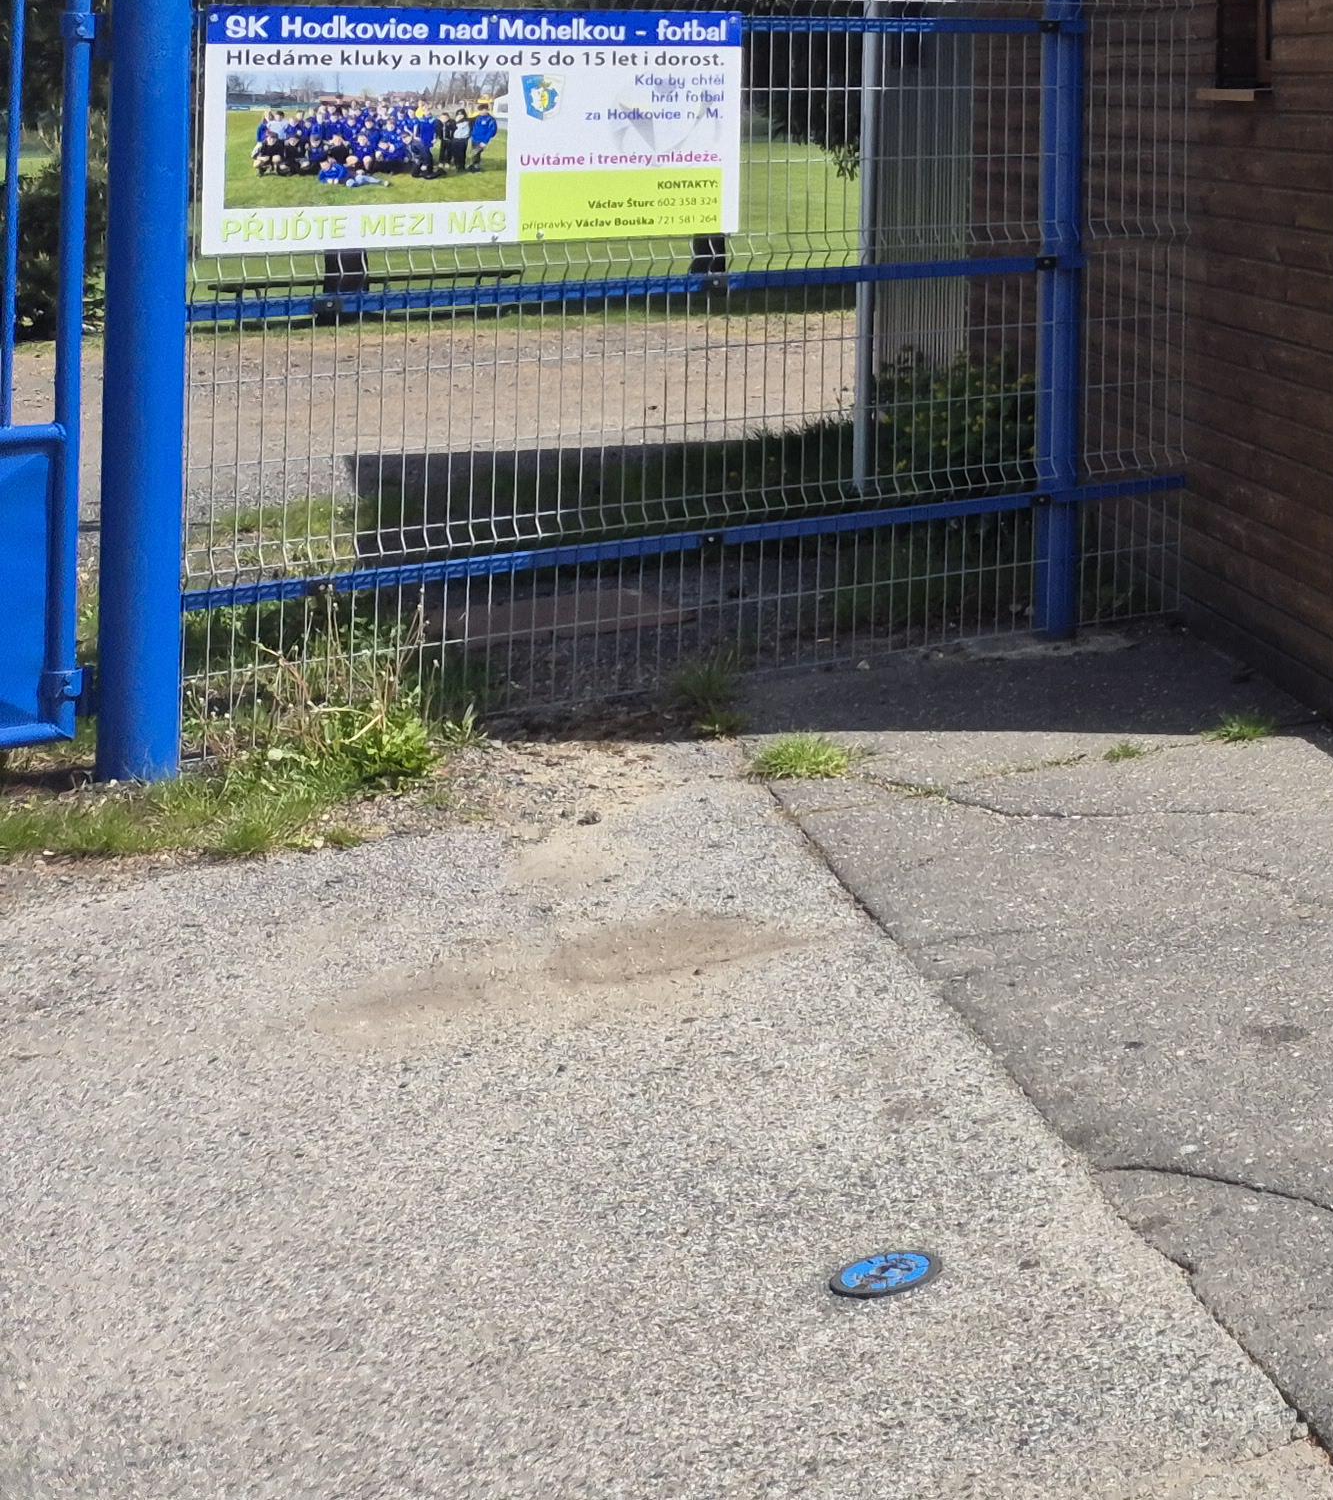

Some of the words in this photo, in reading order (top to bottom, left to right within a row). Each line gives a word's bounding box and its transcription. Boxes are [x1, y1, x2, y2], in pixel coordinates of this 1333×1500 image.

[226, 15, 269, 38] SK
[281, 15, 428, 39] Hodkovice
[439, 17, 488, 40] nad
[499, 18, 625, 41] Mohelkou
[656, 19, 727, 41] fotbal
[226, 50, 333, 66] Hledáme
[341, 50, 402, 69] kluky
[409, 54, 421, 65] a
[429, 50, 489, 69] holky
[495, 51, 523, 66] od
[530, 51, 542, 66] 5
[548, 51, 574, 66] do
[583, 51, 605, 66] 15
[612, 51, 638, 66] let
[643, 52, 649, 66] i
[654, 51, 725, 67] dorost.
[635, 74, 663, 86] Kdo
[669, 74, 685, 89] by
[691, 74, 725, 86] chtěl
[652, 91, 679, 103] hrát
[686, 91, 725, 103] fotbal
[585, 111, 600, 121] za
[607, 108, 681, 121] Hodkovice
[687, 111, 700, 120] n.
[706, 108, 724, 120] M.
[520, 154, 585, 166] Uvítáme
[599, 151, 652, 166] trenéry
[657, 151, 722, 164] mládeže.
[657, 180, 719, 190] KONTAKTY:
[588, 199, 624, 209] Václav
[626, 197, 655, 208] Šturc
[360, 213, 434, 237] MEZI
[447, 205, 506, 234] NÁS
[575, 218, 611, 228] Václav
[615, 216, 654, 226] Bouška
